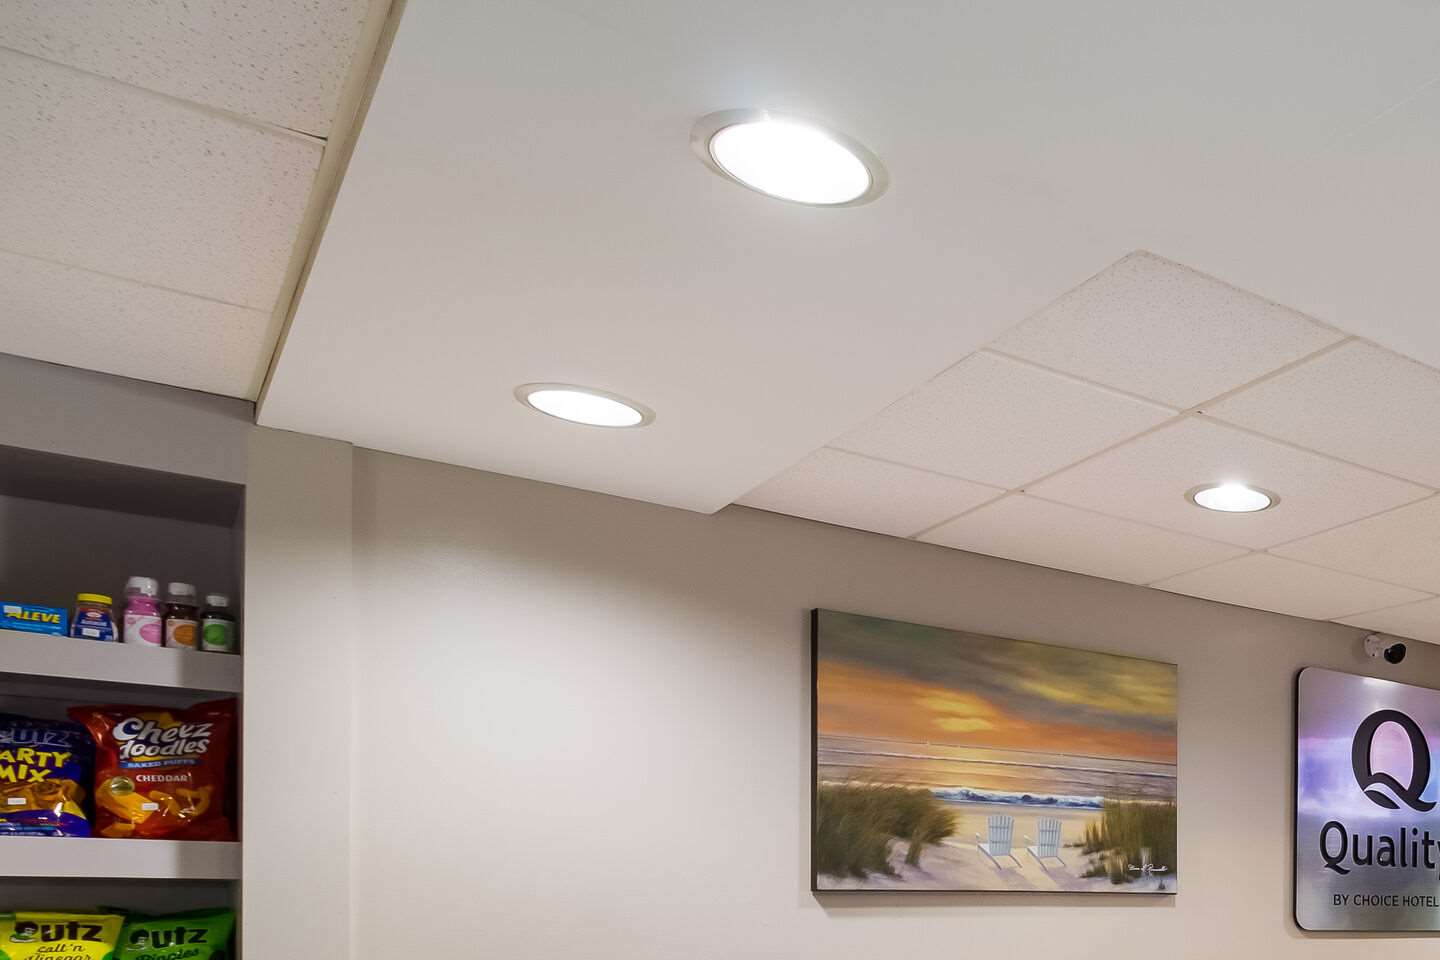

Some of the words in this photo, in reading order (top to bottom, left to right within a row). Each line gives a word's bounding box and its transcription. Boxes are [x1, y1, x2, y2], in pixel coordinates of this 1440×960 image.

[112, 717, 214, 743] Cheez
[0, 747, 72, 768] ARTY
[1351, 709, 1437, 812] Q
[135, 774, 188, 783] CHEDDAR
[1333, 893, 1348, 907] BY
[1353, 894, 1400, 907] CHOICE
